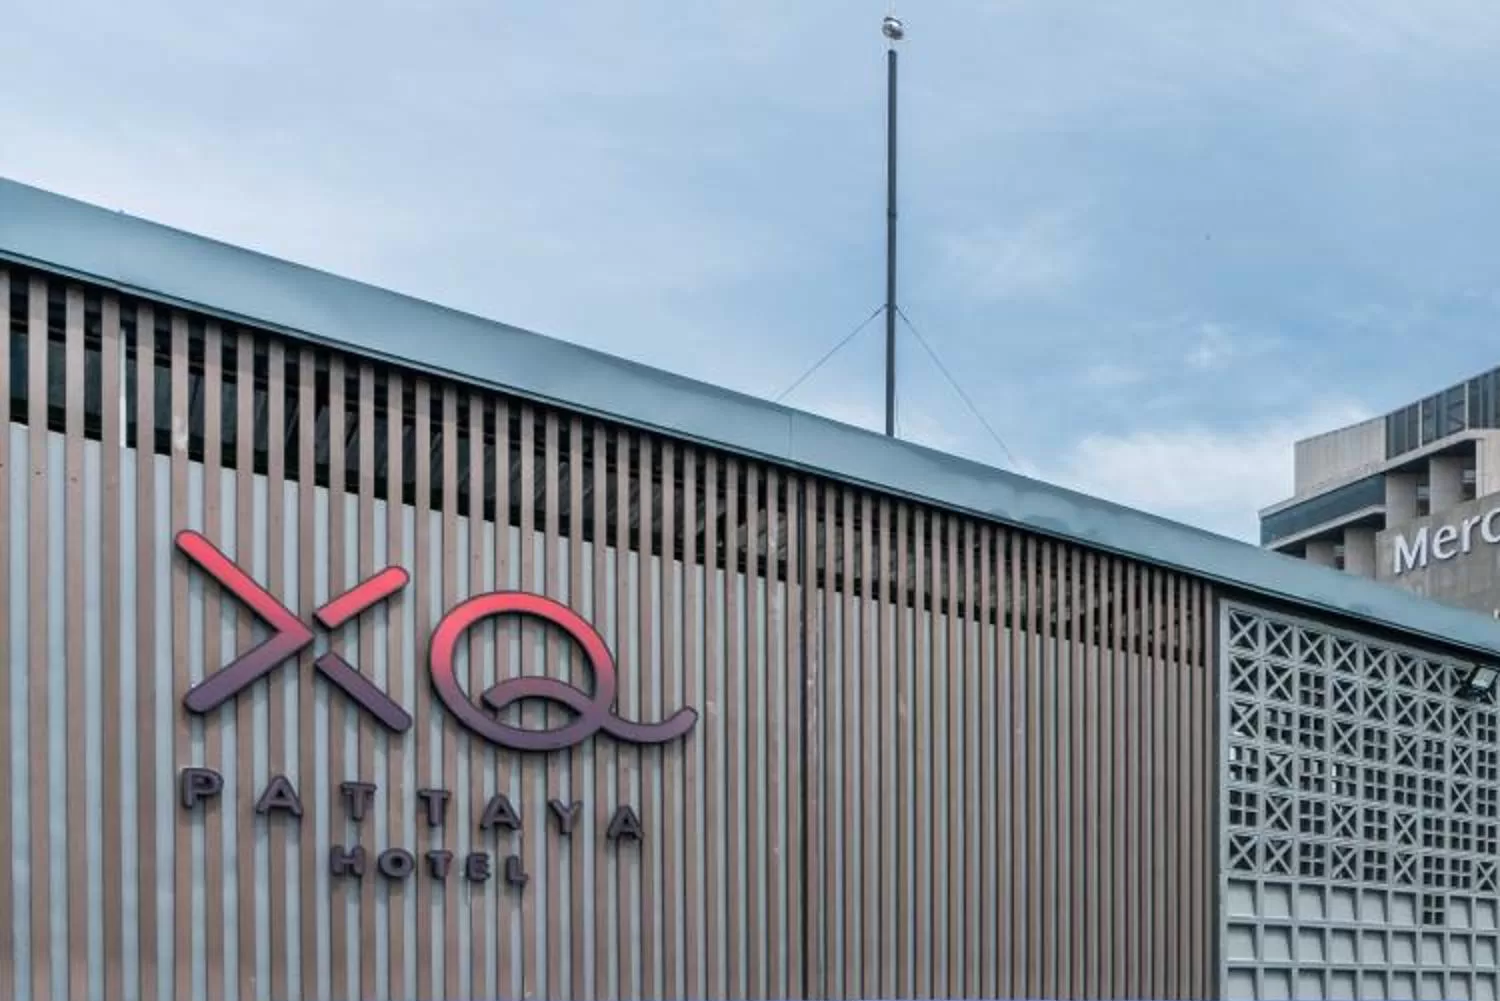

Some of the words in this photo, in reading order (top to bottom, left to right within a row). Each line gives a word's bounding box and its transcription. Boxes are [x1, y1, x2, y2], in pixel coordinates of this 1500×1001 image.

[175, 530, 699, 750] XQ
[182, 768, 644, 840] PATTAYA
[331, 846, 529, 887] HOTEL
